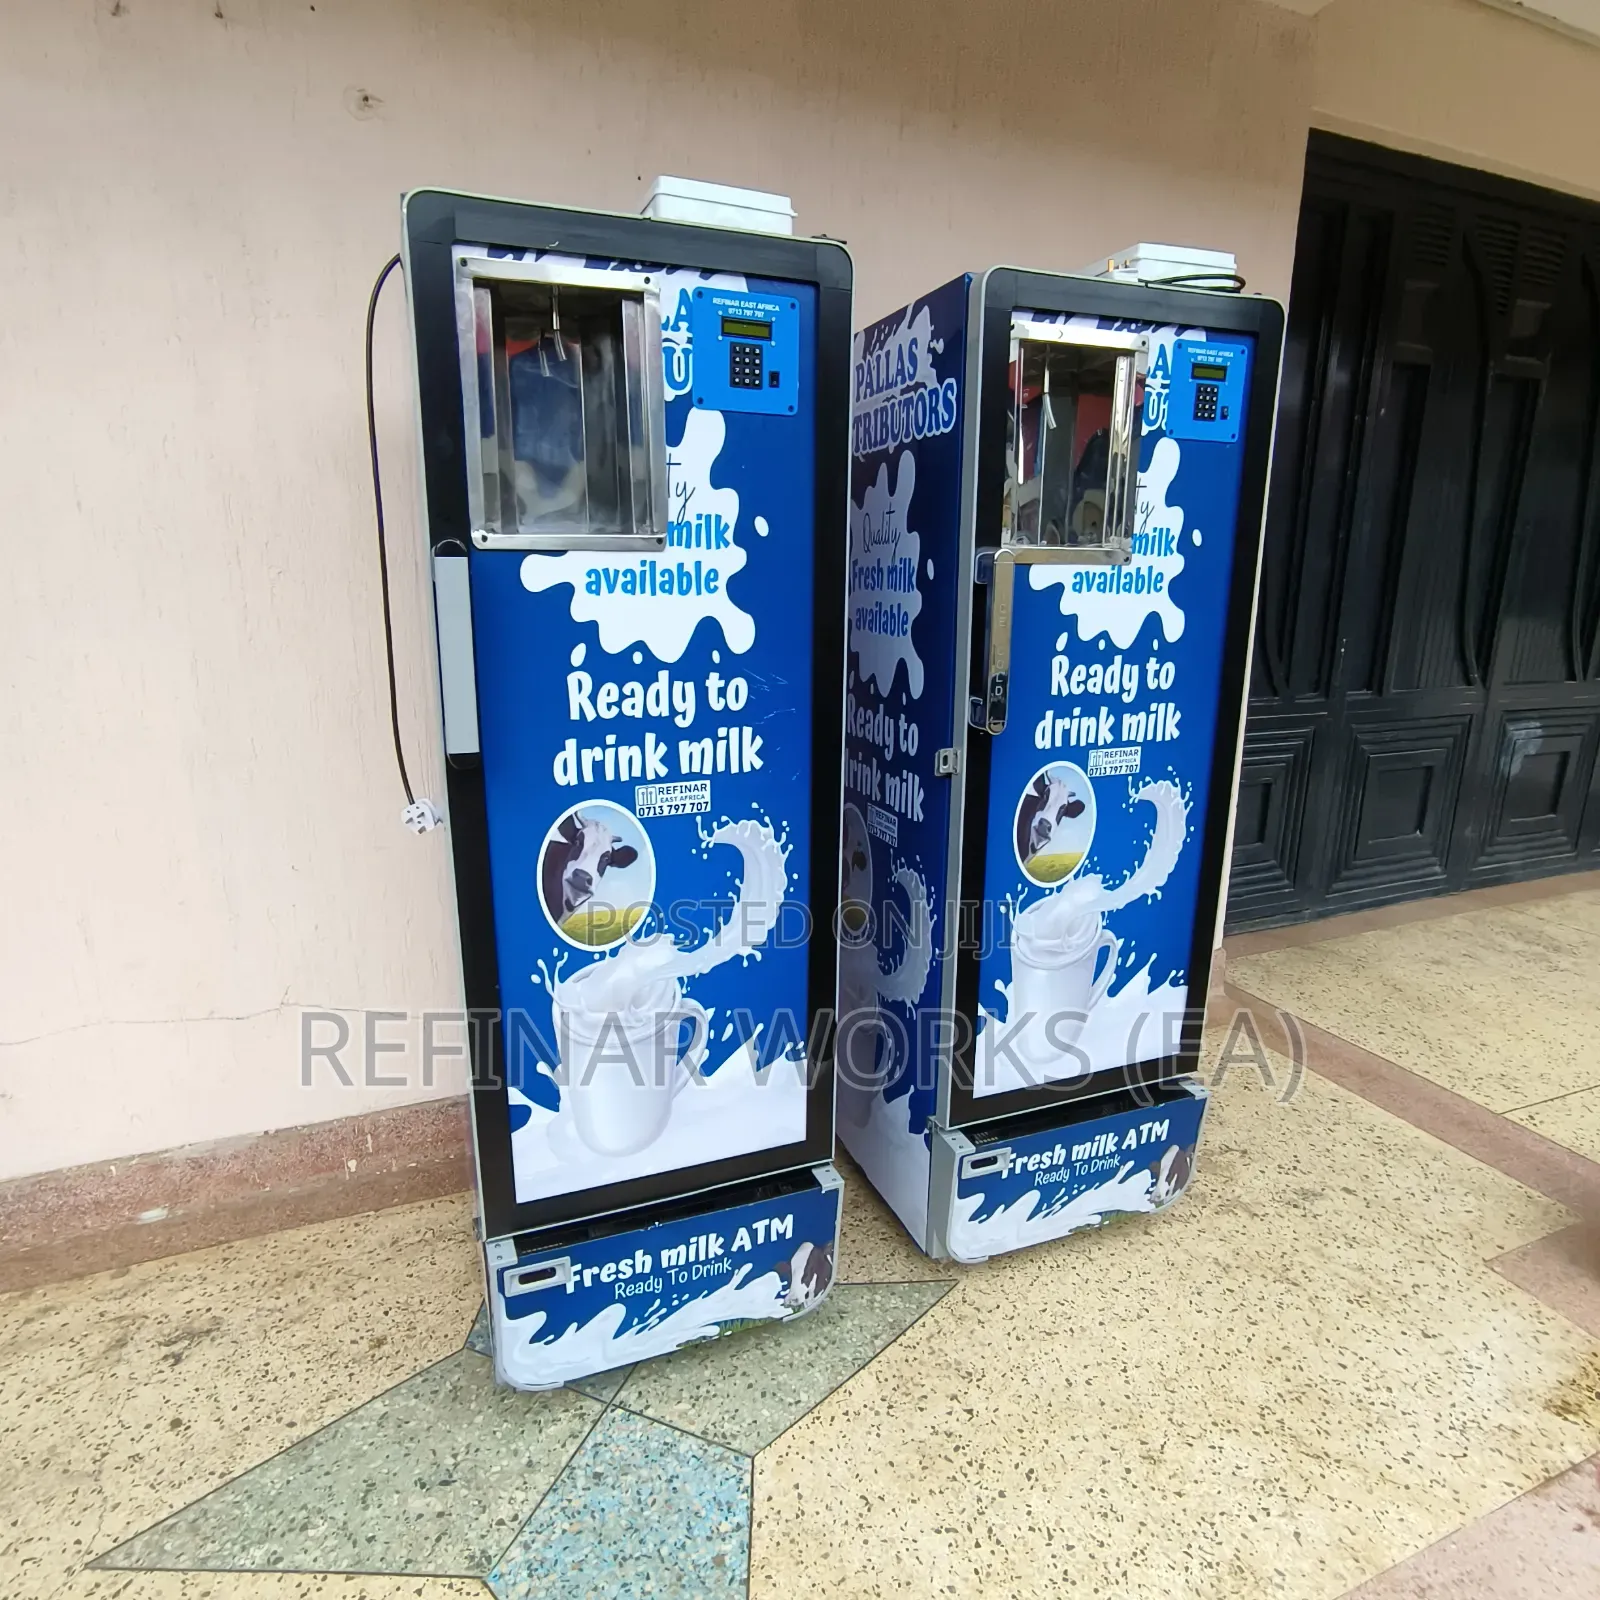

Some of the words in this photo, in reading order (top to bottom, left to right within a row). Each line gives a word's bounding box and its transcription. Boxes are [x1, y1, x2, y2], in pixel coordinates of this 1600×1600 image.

[740, 301, 757, 309] EAST
[757, 303, 780, 312] AFRICA
[855, 337, 918, 403] PALLAS
[853, 382, 955, 454] TRIBUTORS
[667, 513, 730, 550] milk
[863, 501, 901, 566] Quality
[1132, 527, 1175, 557] milk
[585, 560, 719, 596] available
[852, 557, 884, 592] Fresh
[887, 557, 915, 593] milk
[1072, 565, 1164, 595] available
[855, 601, 909, 637] available
[1051, 655, 1139, 703] Ready
[1146, 657, 1175, 690] to
[567, 670, 696, 728] Ready
[705, 672, 748, 711] to
[847, 693, 894, 761] Ready
[899, 713, 918, 756] to
[1035, 706, 1115, 749] drink
[1122, 702, 1181, 742] milk
[553, 733, 669, 786] drink
[678, 726, 764, 774] milk
[1089, 766, 1107, 776] 0713
[1109, 765, 1123, 774] 797
[1124, 764, 1138, 773] 707
[1104, 749, 1139, 759] REFINAR
[658, 783, 707, 796] REFINAR
[660, 796, 678, 804] EAST
[680, 794, 705, 802] AFRICA
[886, 769, 924, 822] milk
[638, 804, 664, 817] 0713
[667, 803, 687, 815] 797
[689, 801, 709, 813] 707
[1001, 1144, 1066, 1180] Fresh
[1071, 1131, 1118, 1162] milk
[1121, 1119, 1170, 1151] ATM
[1034, 1165, 1070, 1187] Ready
[1073, 1162, 1090, 1177] To
[1090, 1154, 1120, 1175] Drink
[565, 1249, 651, 1294] Fresh
[660, 1232, 725, 1270] milk
[731, 1214, 794, 1253] ATM
[614, 1275, 663, 1301] Ready
[667, 1268, 688, 1286] To
[692, 1257, 732, 1279] Drink
